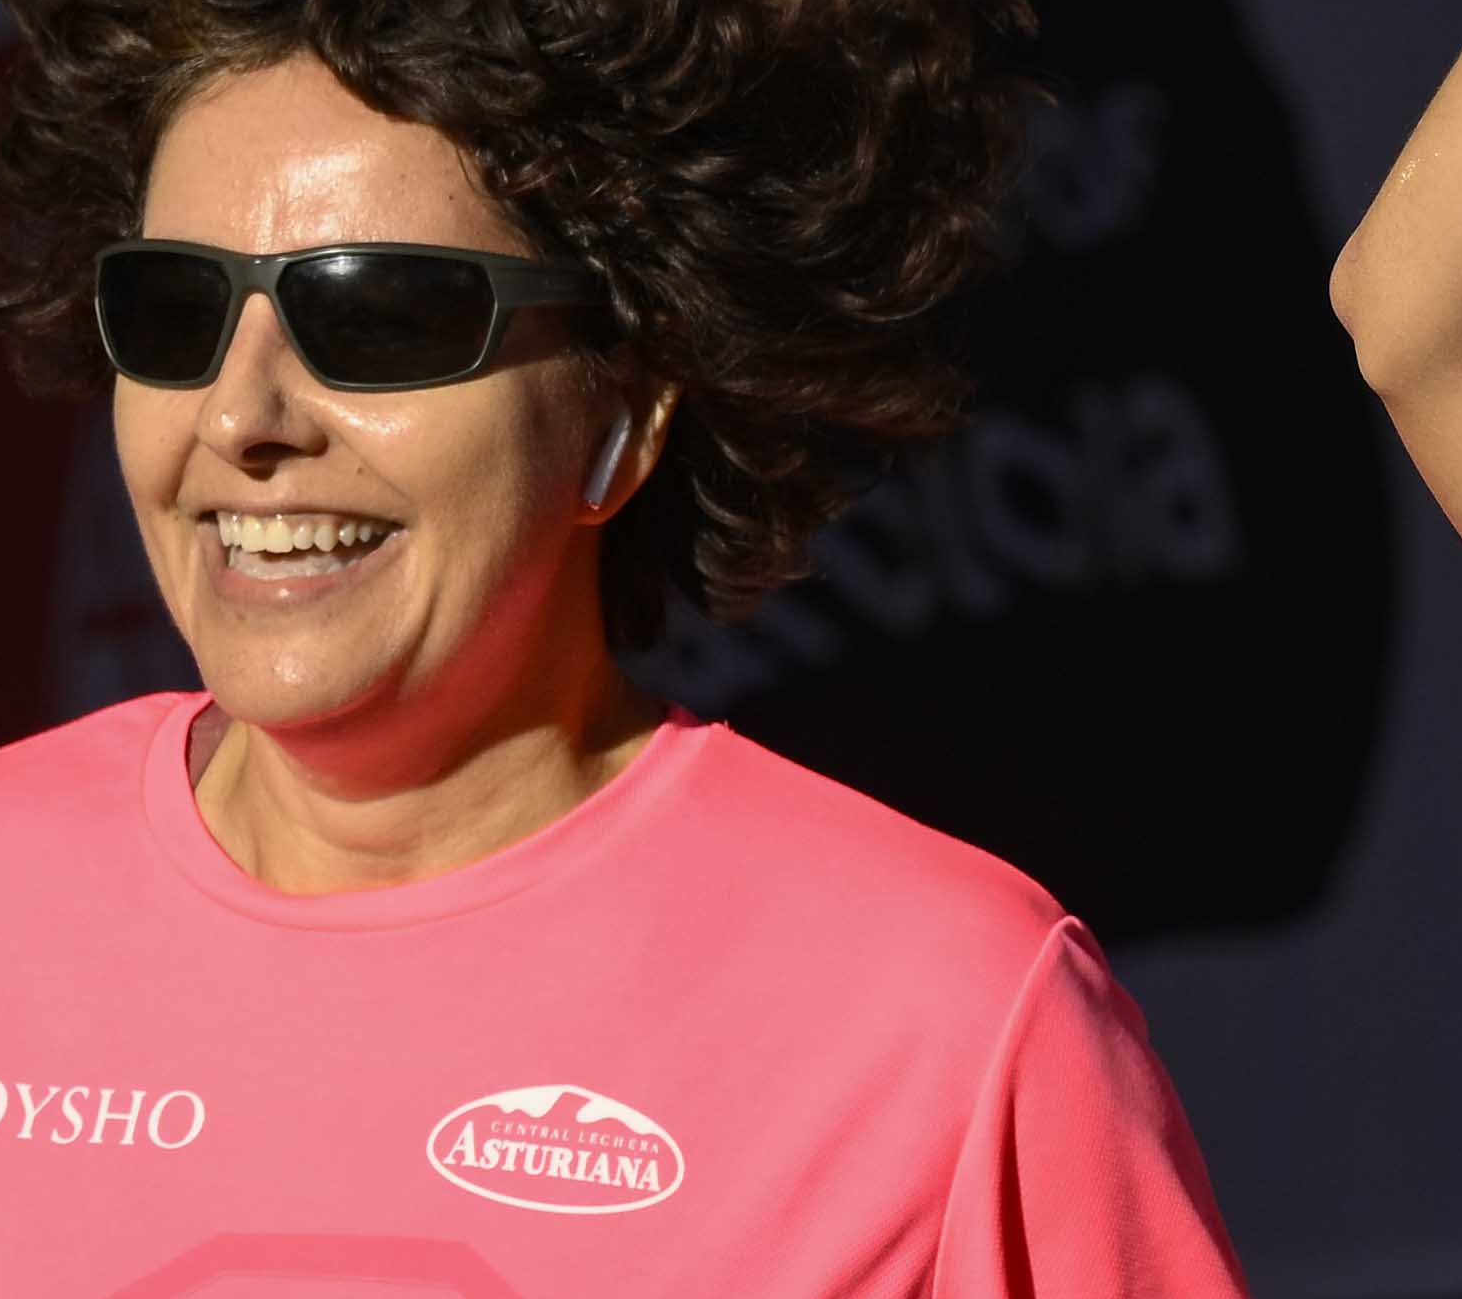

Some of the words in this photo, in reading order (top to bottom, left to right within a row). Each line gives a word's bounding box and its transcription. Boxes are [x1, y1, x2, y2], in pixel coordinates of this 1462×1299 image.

[443, 1120, 661, 1192] ASTURIANA
[491, 1120, 569, 1141] CENTRAL
[578, 1131, 659, 1154] LECHERA
